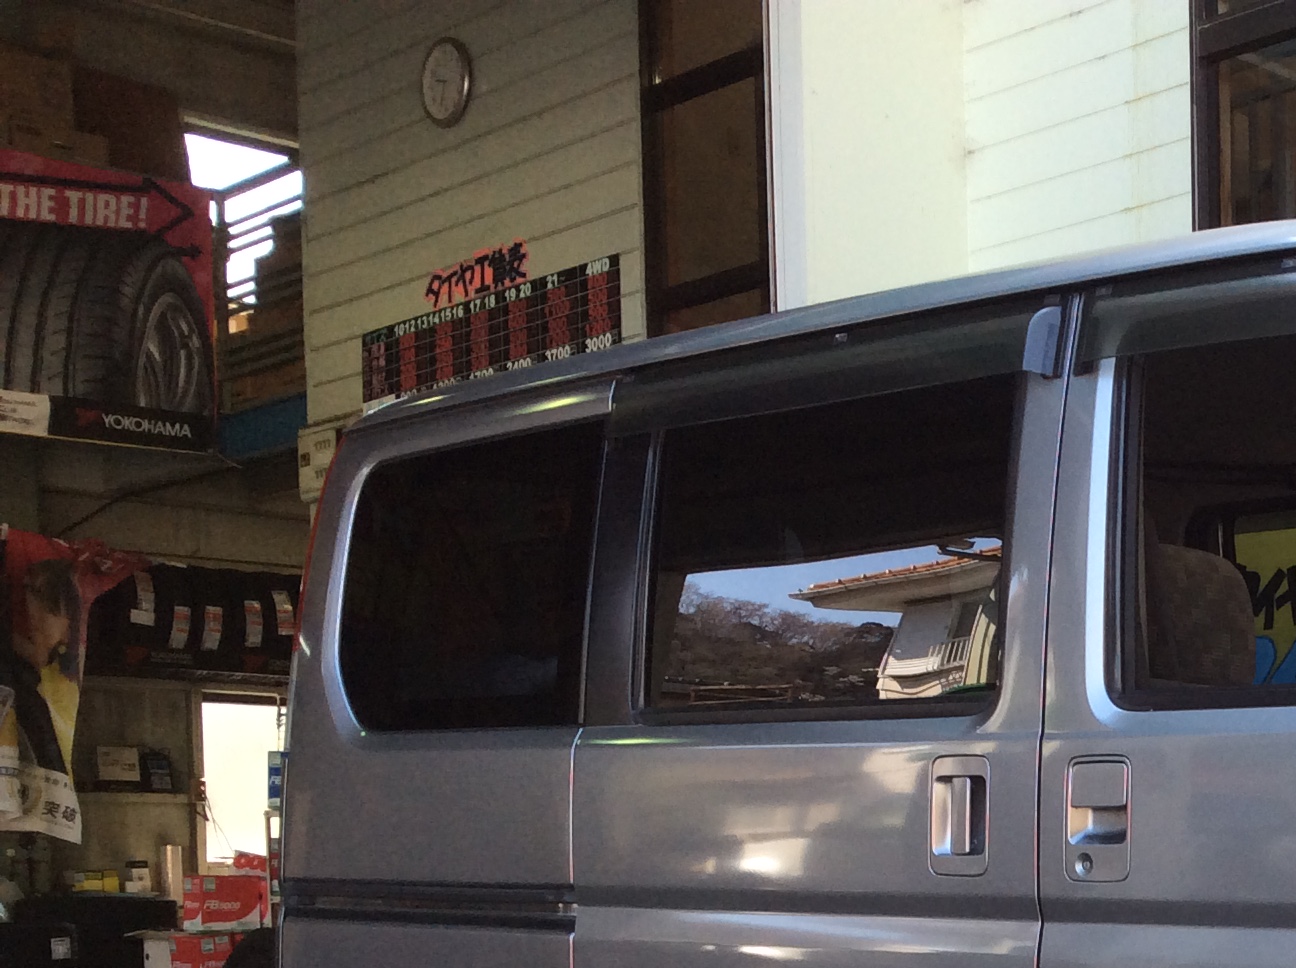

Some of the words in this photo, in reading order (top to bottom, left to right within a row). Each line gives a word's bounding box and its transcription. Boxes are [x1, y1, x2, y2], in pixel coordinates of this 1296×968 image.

[0, 183, 56, 221] THE
[64, 190, 148, 228] TIRE!
[585, 258, 610, 275] 4WD
[470, 299, 481, 314] 17
[484, 294, 496, 308] 18
[505, 288, 516, 302] 19
[519, 282, 532, 297] 20
[585, 333, 612, 353] 3000
[102, 413, 192, 438] YOKOHAMA
